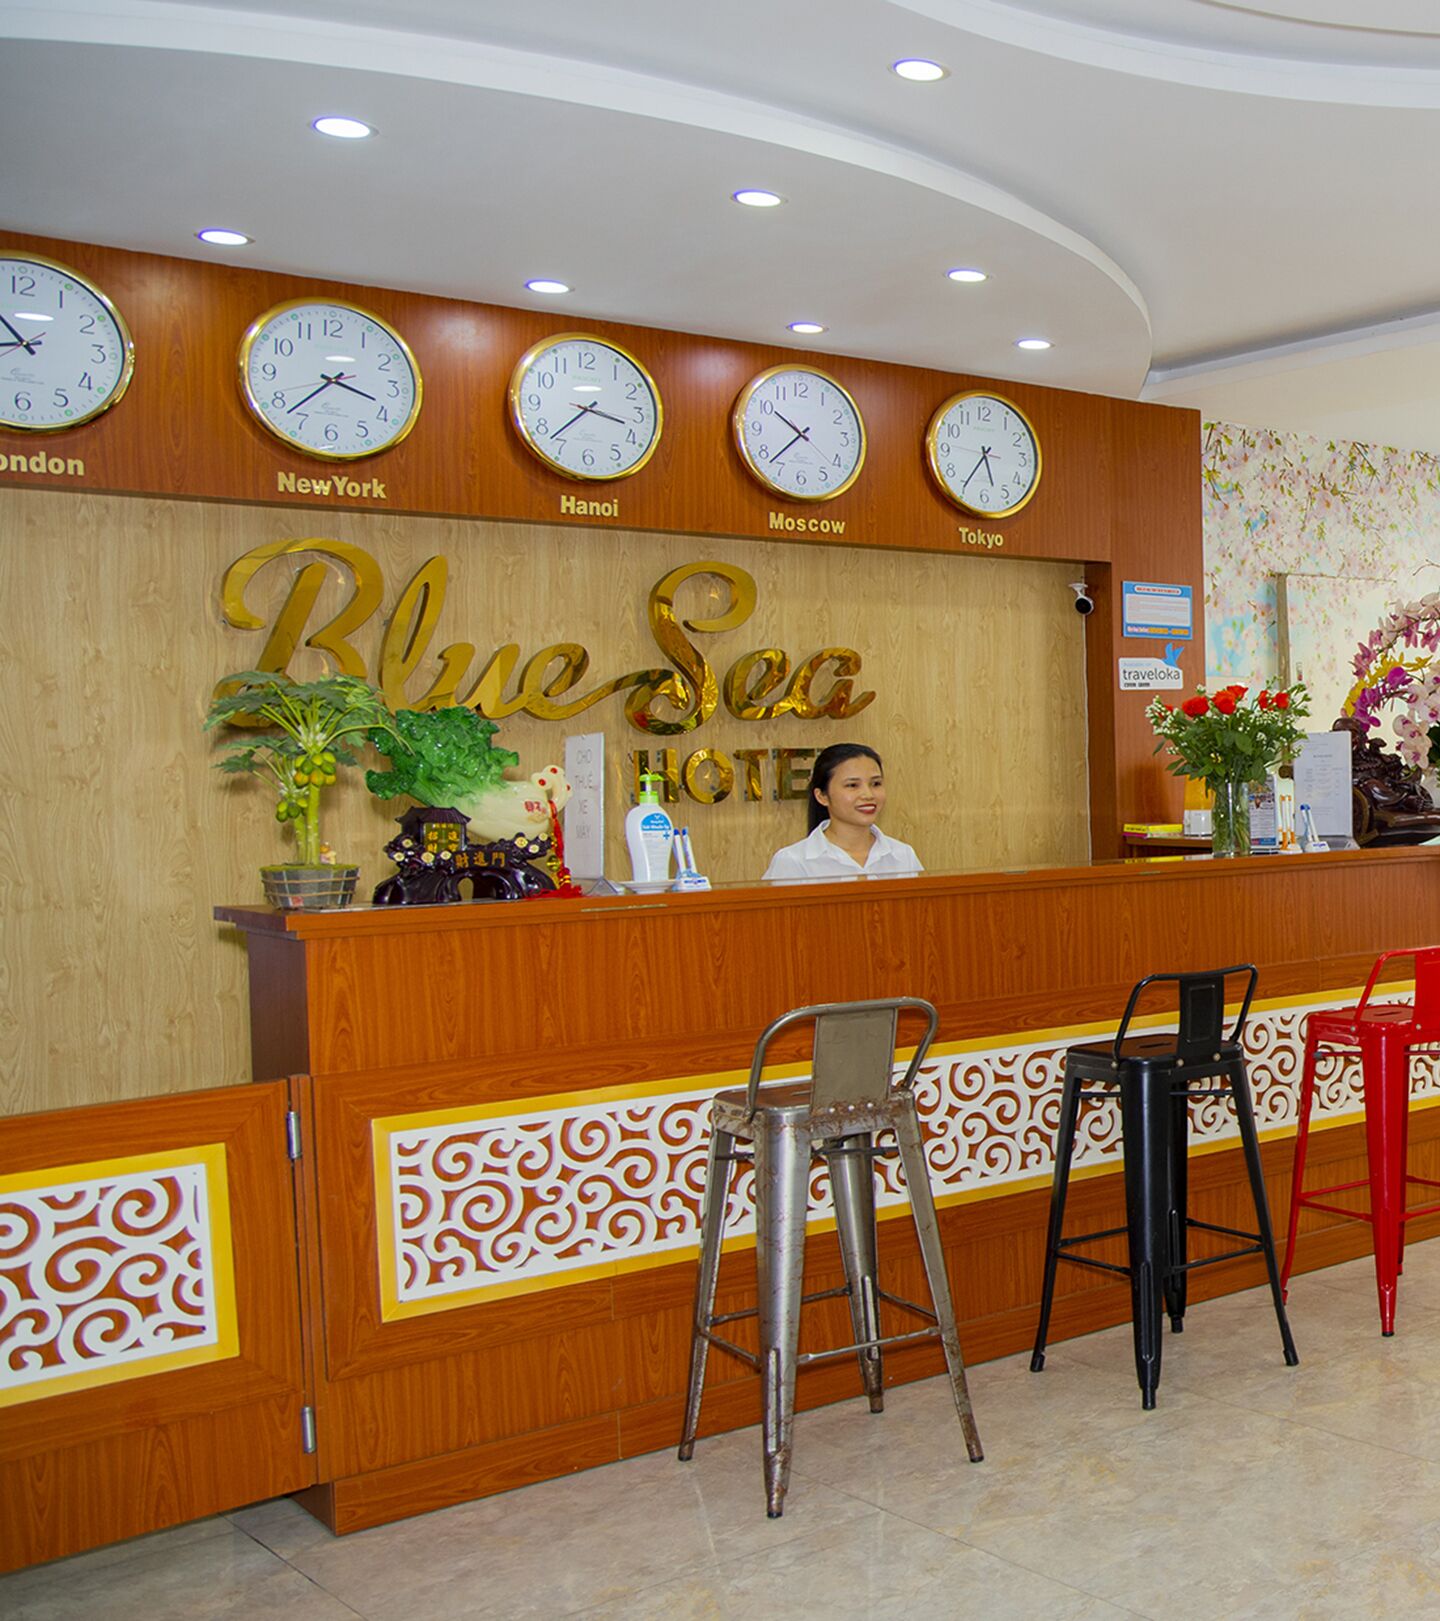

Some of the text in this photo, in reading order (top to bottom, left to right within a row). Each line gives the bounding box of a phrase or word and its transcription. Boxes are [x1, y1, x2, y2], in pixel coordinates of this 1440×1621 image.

[12, 275, 36, 297] 12
[79, 314, 95, 335] 2
[298, 322, 311, 340] 11
[323, 319, 344, 338] 12
[91, 344, 106, 364] 3
[274, 338, 294, 357] 10
[377, 353, 391, 372] 2
[555, 356, 567, 374] 11
[578, 352, 596, 370] 12
[262, 362, 277, 381] 9
[537, 371, 554, 390] 10
[78, 372, 93, 391] 4
[387, 380, 399, 398] 3
[794, 382, 808, 398] 12
[53, 388, 69, 408] 5
[271, 391, 286, 409] 8
[625, 382, 638, 400] 2
[776, 385, 786, 400] 11
[14, 391, 32, 411] 6
[528, 394, 541, 411] 9
[760, 400, 774, 416] 10
[296, 412, 309, 430] 7
[376, 405, 388, 422] 4
[632, 406, 644, 424] 3
[833, 409, 843, 425] 2
[960, 410, 970, 425] 11
[977, 406, 992, 422] 12
[324, 423, 338, 442] 6
[356, 420, 369, 438] 5
[536, 417, 549, 435] 8
[751, 420, 762, 436] 9
[947, 423, 960, 439] 10
[625, 428, 637, 446] 4
[840, 432, 849, 448] 3
[1012, 432, 1022, 448] 2
[555, 438, 567, 455] 7
[609, 444, 622, 462] 5
[758, 443, 770, 460] 8
[940, 442, 950, 458] 9
[582, 449, 595, 466] 6
[832, 453, 842, 468] 4
[1018, 452, 1027, 468] 3
[776, 461, 785, 477] 7
[796, 470, 807, 486] 6
[818, 466, 828, 482] 5
[946, 463, 956, 478] 8
[1012, 471, 1021, 485] 4
[277, 471, 387, 499] NewYork
[1001, 485, 1010, 500] 5
[979, 489, 989, 504] 6
[560, 495, 619, 517] Hanoi
[769, 511, 846, 534] Moscow
[958, 526, 1004, 549] Tokyo
[213, 538, 877, 736] Blue Sea
[1122, 667, 1181, 681] traveloka
[631, 748, 823, 804] HOTE
